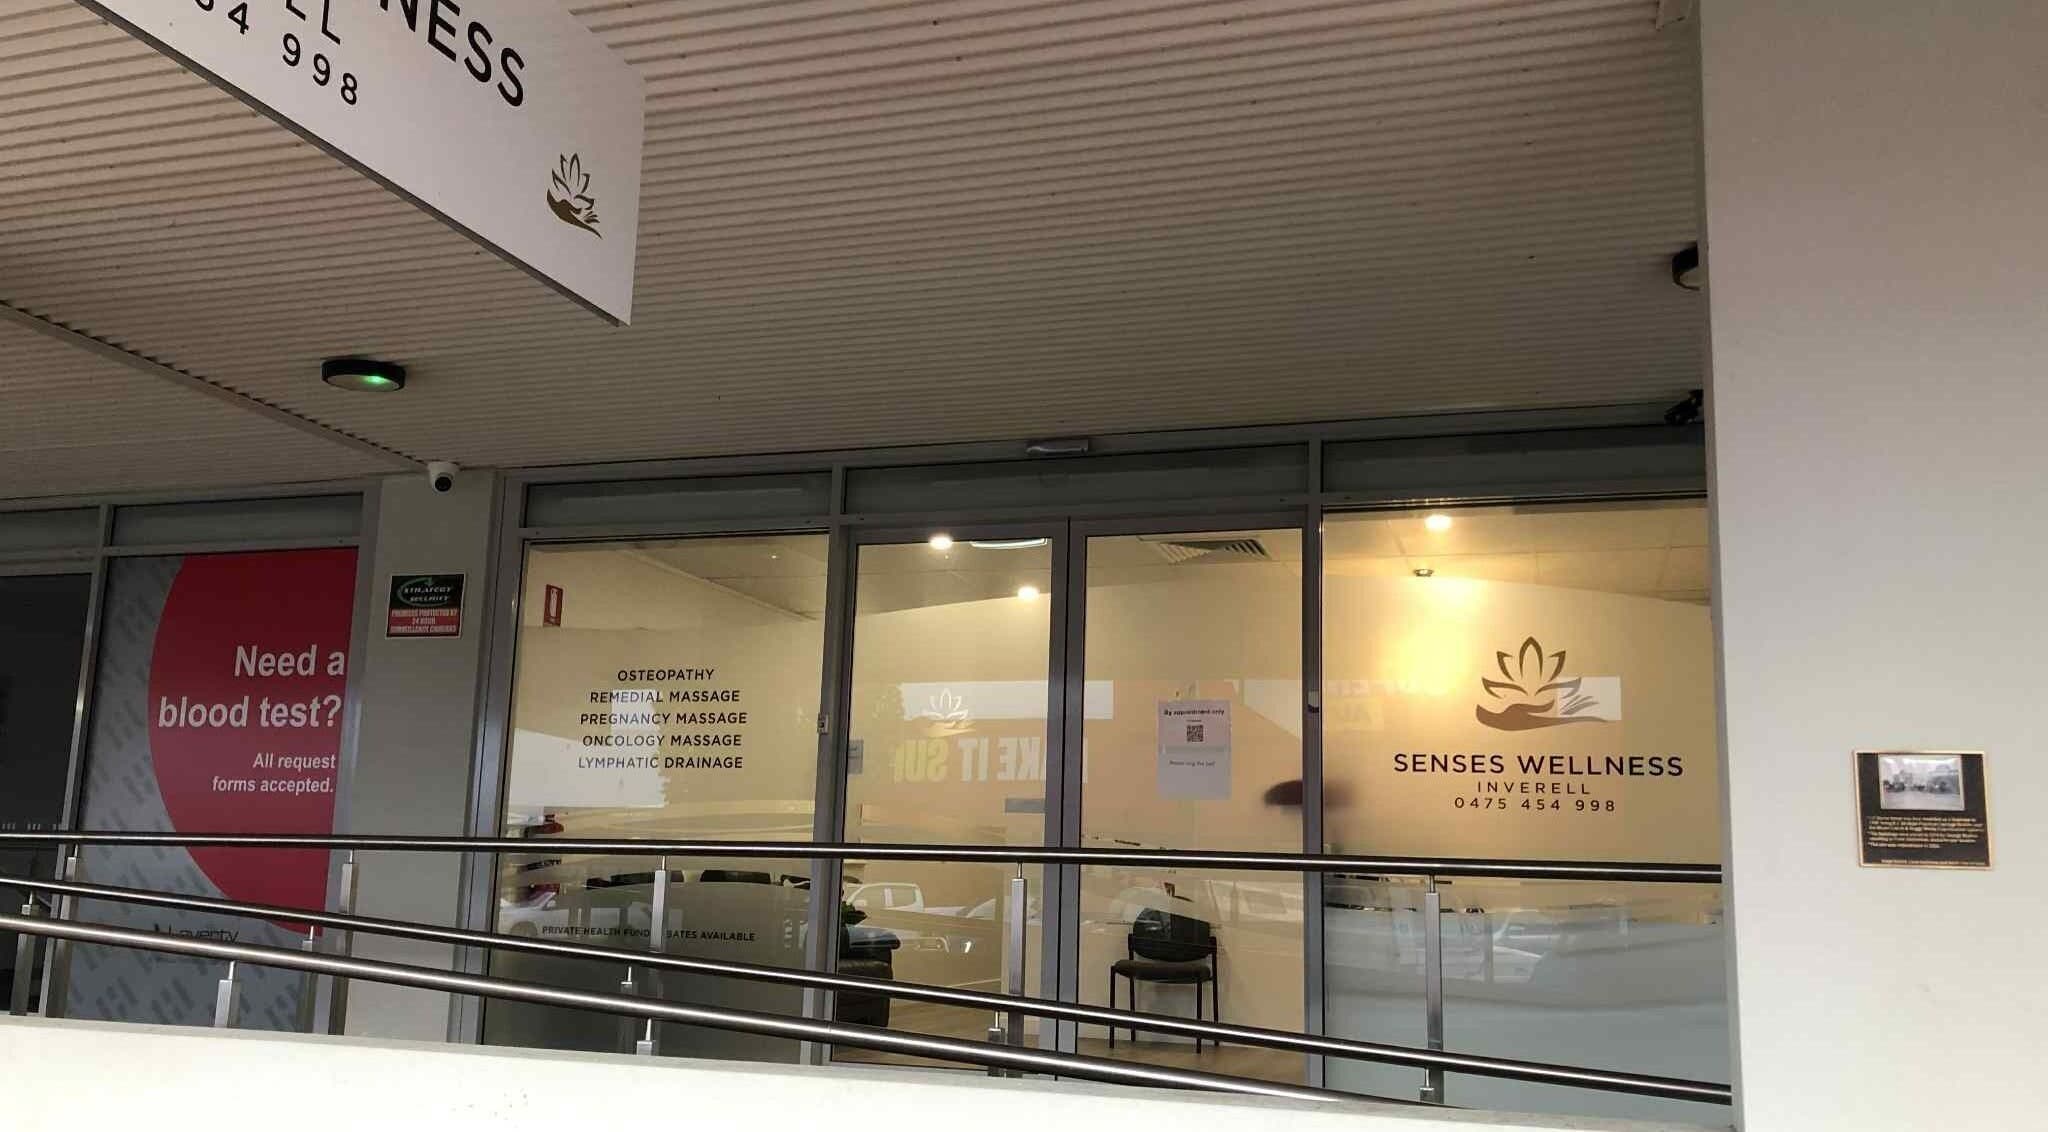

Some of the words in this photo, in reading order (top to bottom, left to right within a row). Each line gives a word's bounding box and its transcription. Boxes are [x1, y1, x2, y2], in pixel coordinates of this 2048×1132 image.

[282, 33, 358, 106] 998
[234, 644, 318, 677] Need
[326, 651, 345, 676] a
[617, 669, 715, 682] OSTEOPATHY
[590, 691, 664, 703] REMEDIAL
[669, 690, 741, 702] MASSAGE
[158, 695, 250, 728] blood
[259, 694, 342, 728] test?
[580, 713, 671, 725] PREGNANCY
[676, 712, 748, 724] MASSAGE
[582, 735, 665, 746] ONCOLOGY
[670, 735, 742, 746] MASSAGE
[252, 753, 274, 769] All
[278, 754, 336, 772] request
[578, 757, 660, 769] LYMPHATIC
[664, 756, 744, 769] DRAINAGE
[1393, 753, 1505, 774] SENSES
[1517, 755, 1684, 776] WELLNESS
[212, 776, 256, 792] forms
[260, 777, 334, 795] accepted.
[1477, 781, 1591, 795] INVERELL
[1454, 796, 1507, 809] 0475
[1521, 798, 1561, 810] 454
[1575, 800, 1616, 812] 998
[542, 926, 580, 936] PRIVATE
[583, 927, 622, 937] HEALTH
[700, 930, 755, 942] AVAILABLE
